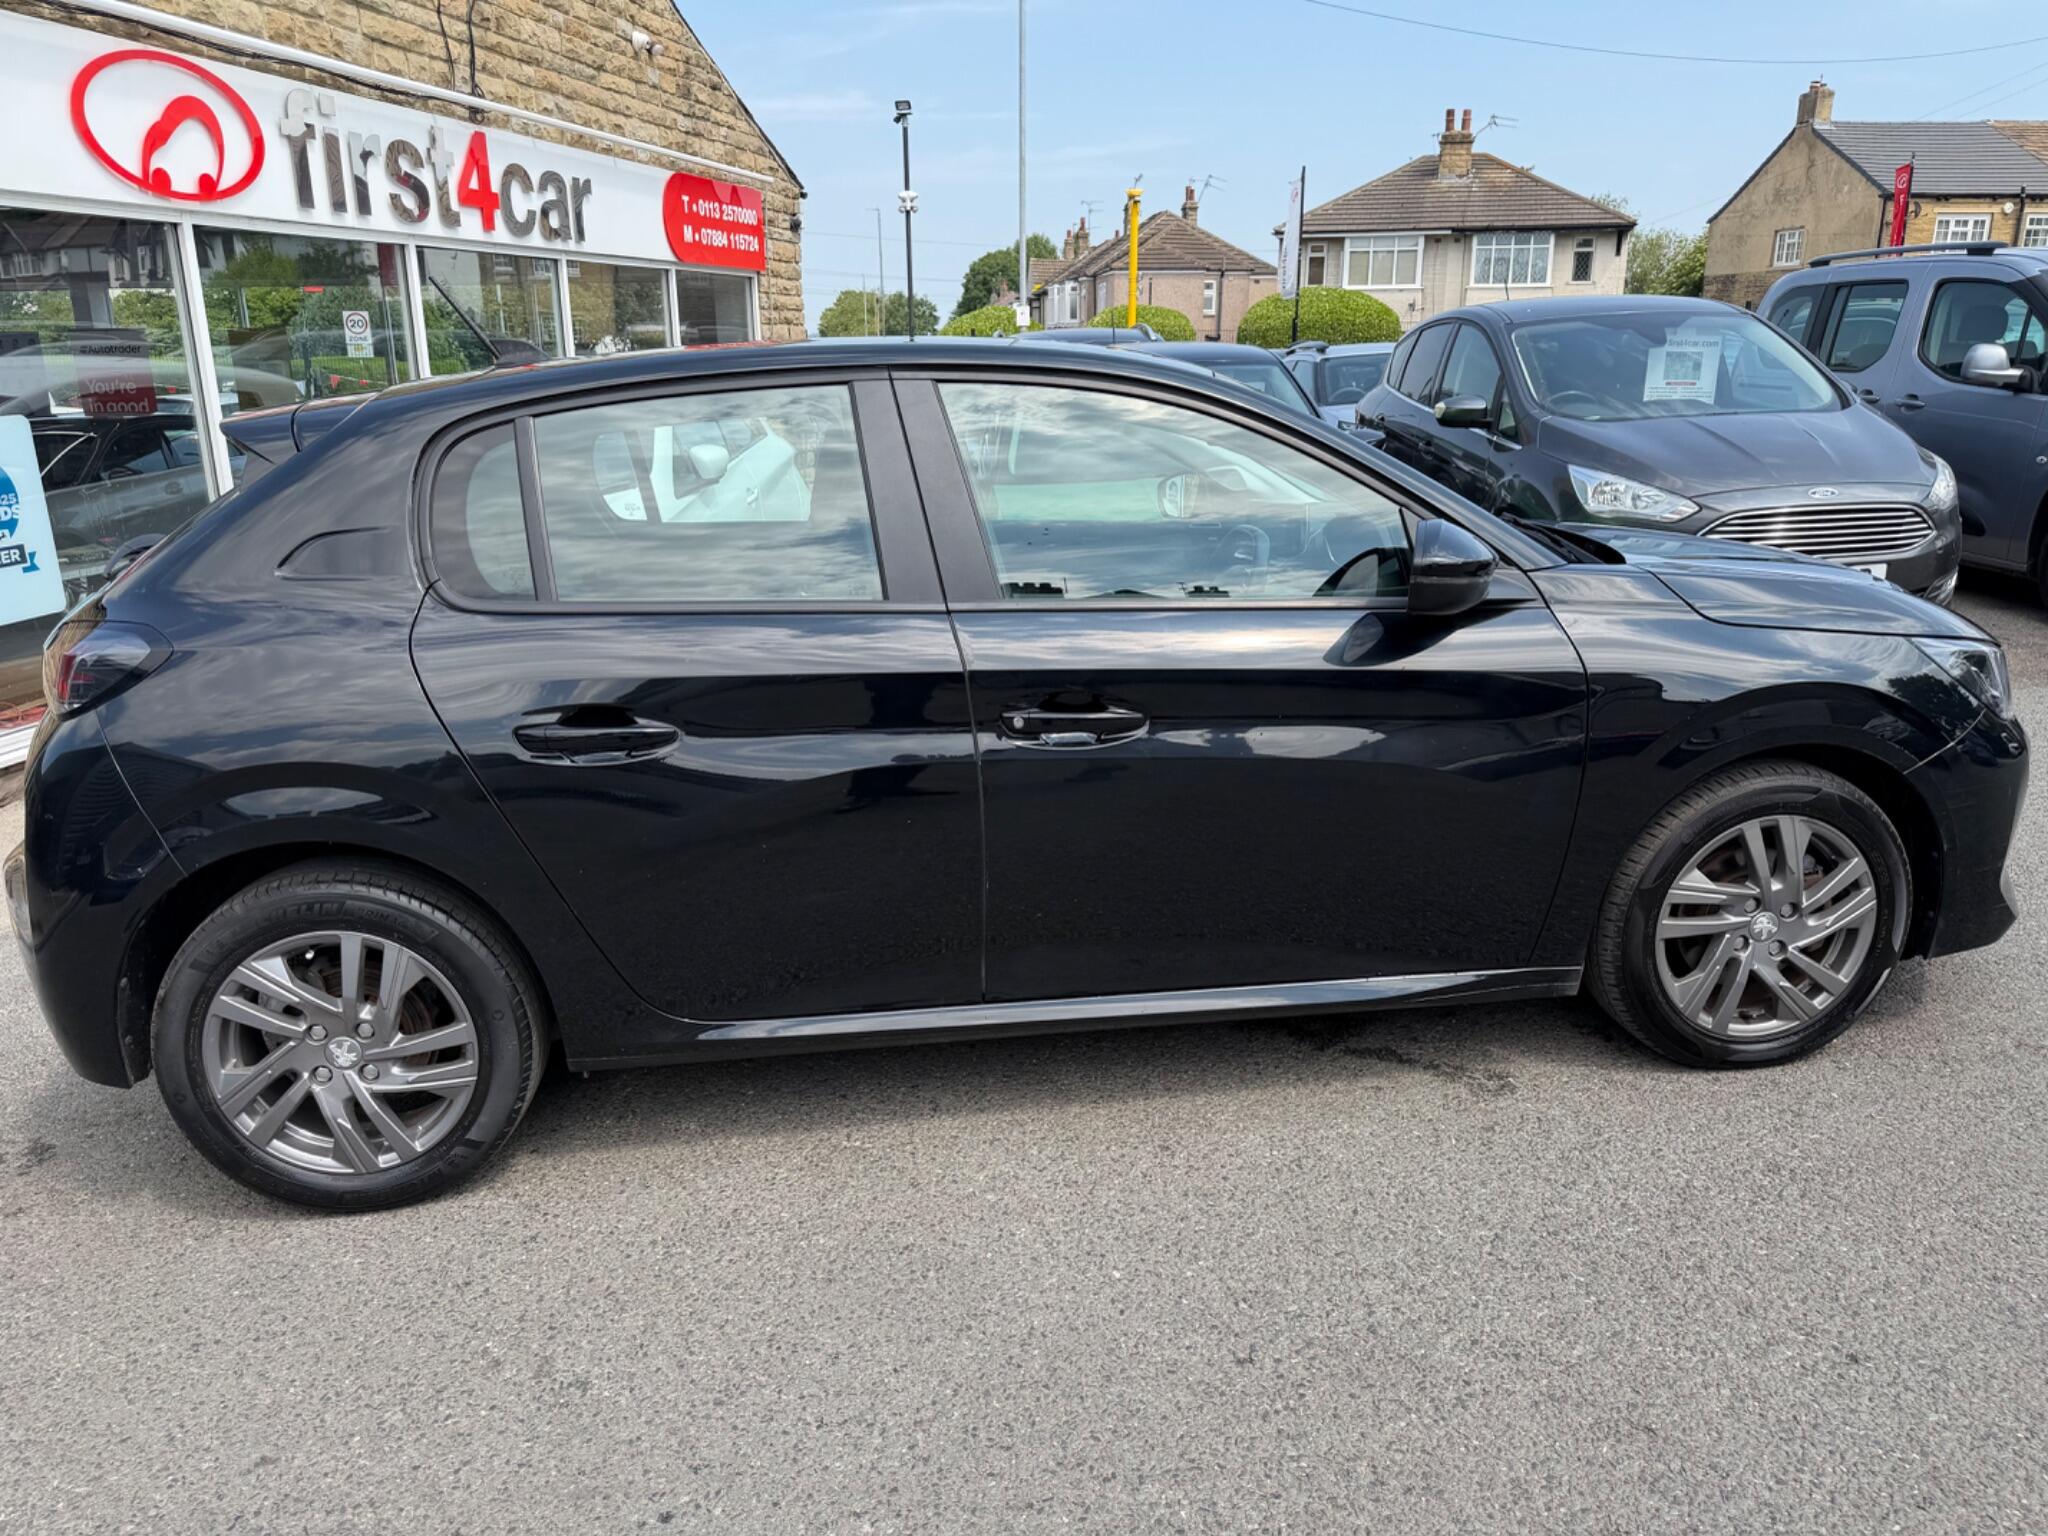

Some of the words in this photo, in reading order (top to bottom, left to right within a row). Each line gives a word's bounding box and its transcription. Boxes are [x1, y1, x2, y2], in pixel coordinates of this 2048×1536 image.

[280, 89, 593, 243] first4car
[681, 194, 690, 213] T
[698, 199, 720, 220] 0113
[722, 203, 758, 226] 2570000
[683, 224, 693, 244] M
[700, 227, 728, 249] 07884
[729, 233, 759, 252] 115724
[349, 319, 365, 329] 20
[88, 344, 142, 354] Autotrader
[86, 380, 137, 394] You're
[89, 399, 104, 413] in
[0, 492, 17, 506] 25
[0, 504, 20, 521] DS
[0, 548, 22, 565] ER
